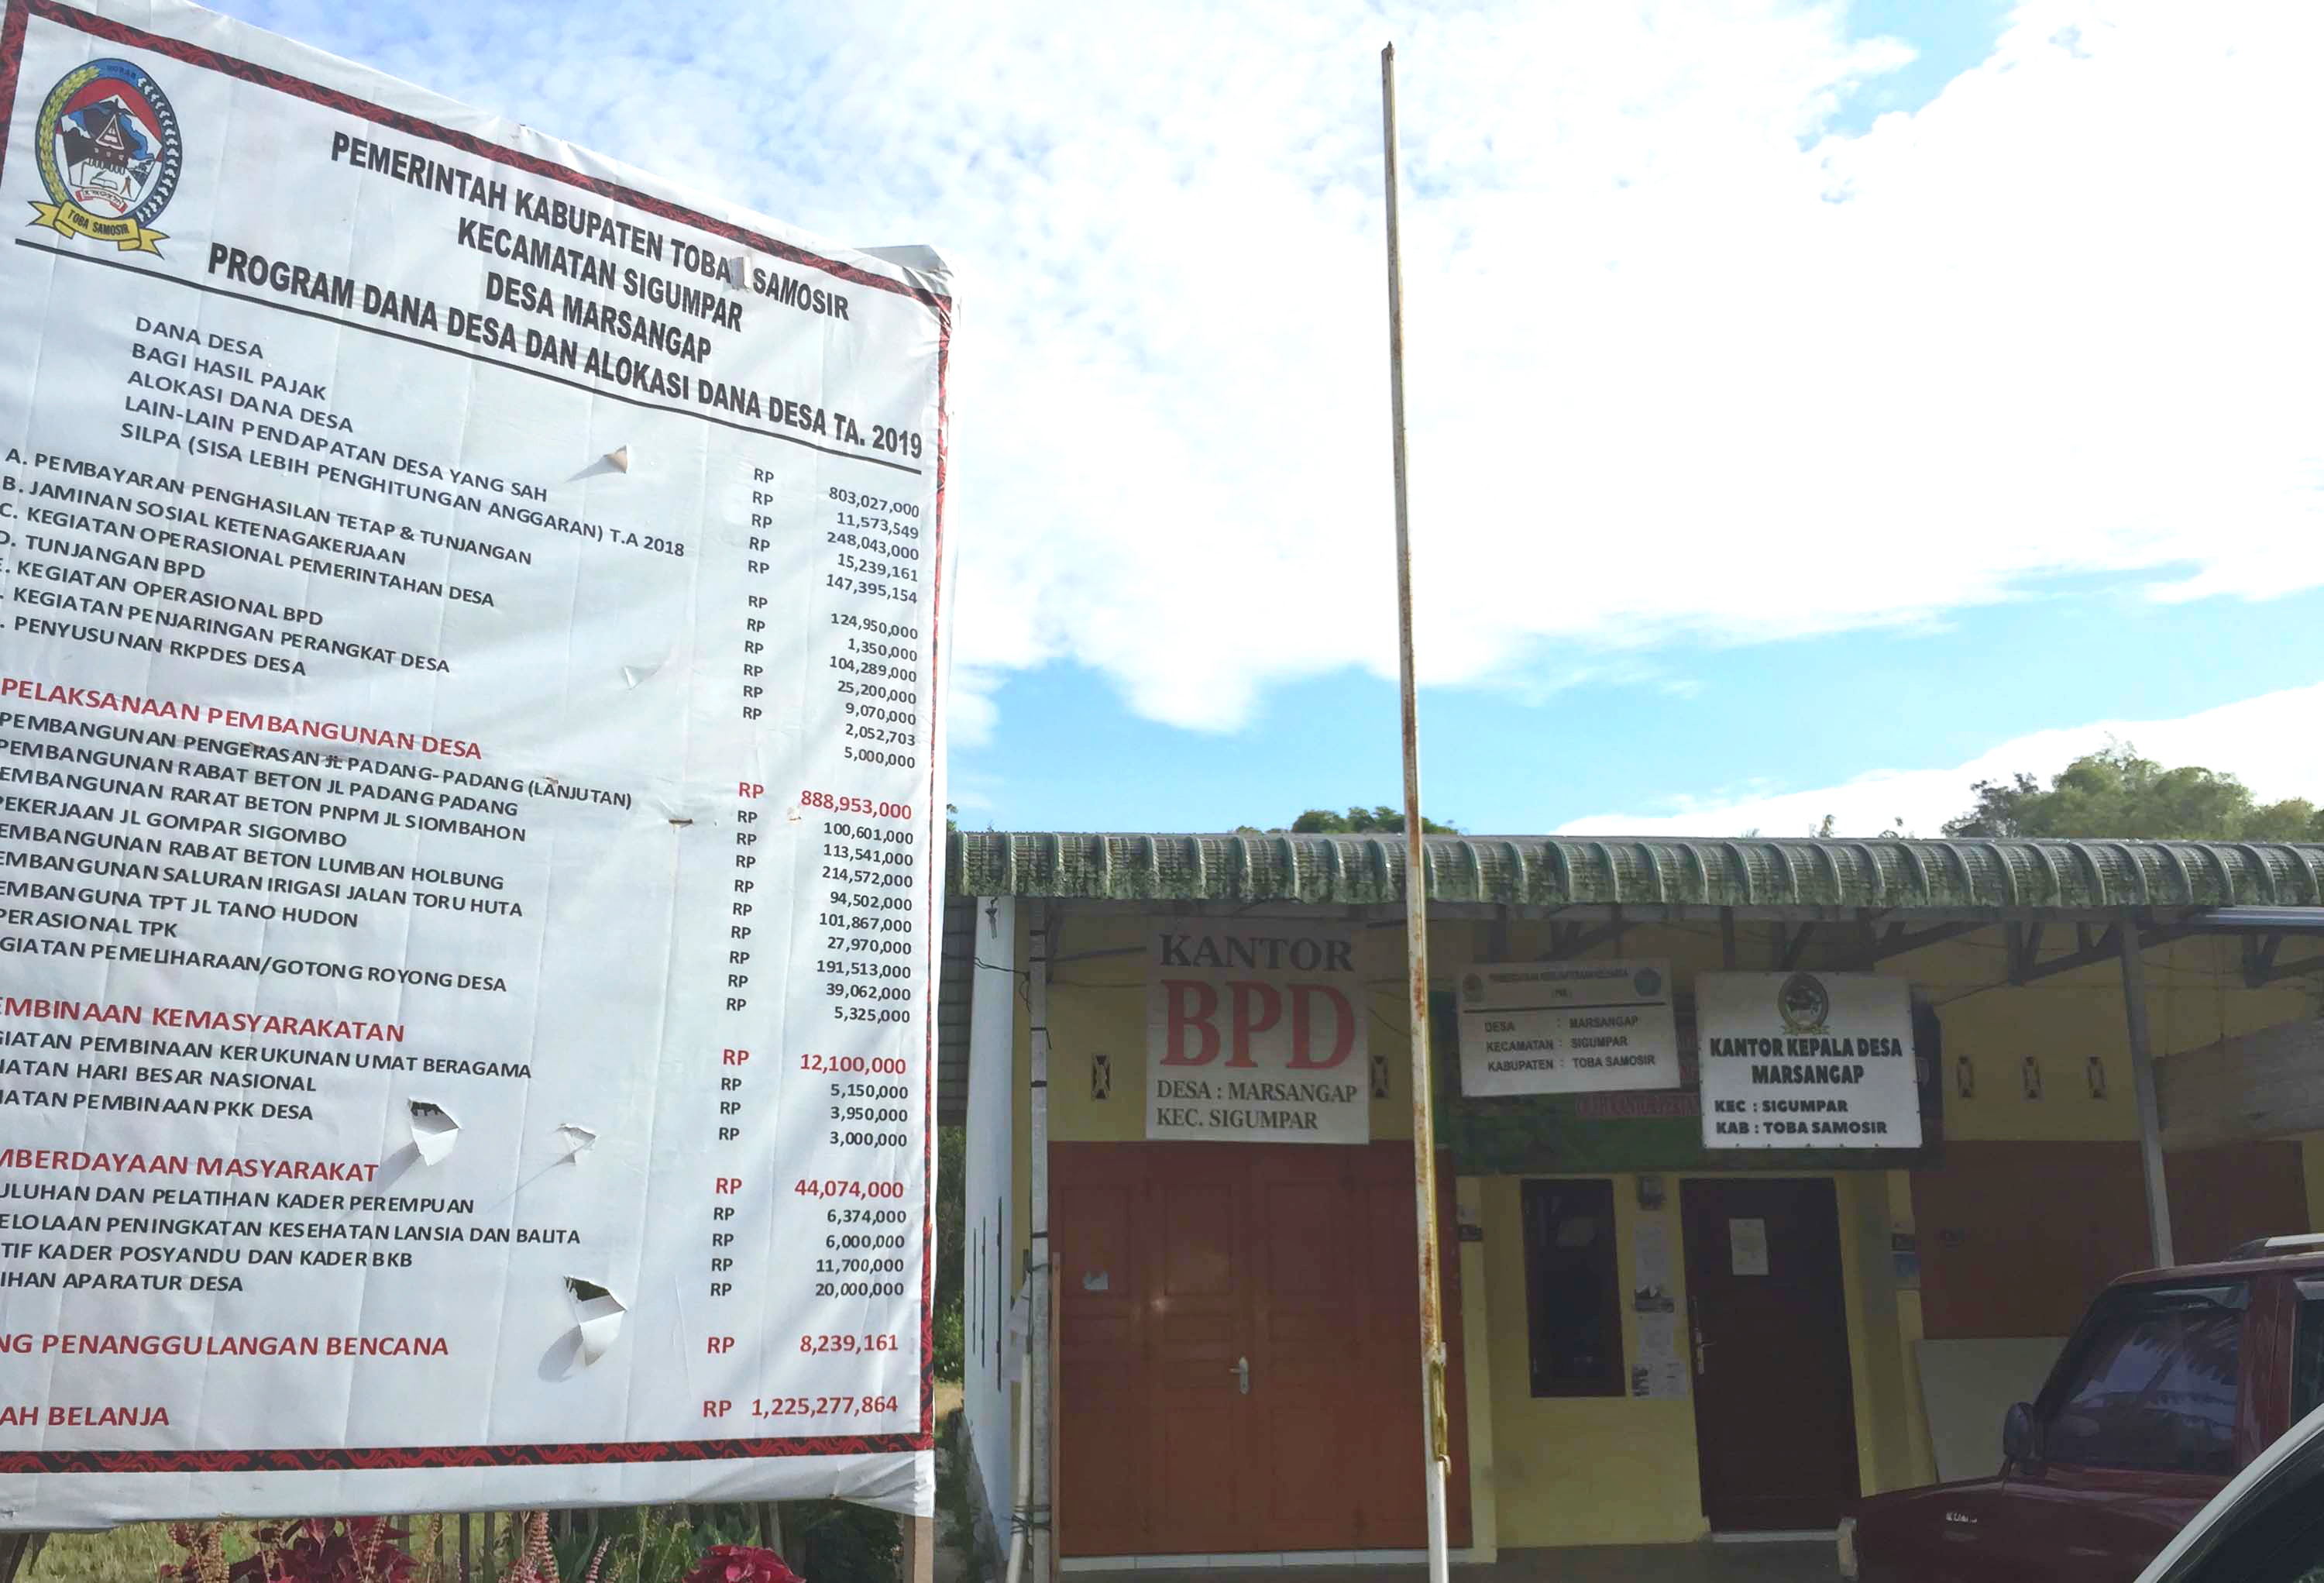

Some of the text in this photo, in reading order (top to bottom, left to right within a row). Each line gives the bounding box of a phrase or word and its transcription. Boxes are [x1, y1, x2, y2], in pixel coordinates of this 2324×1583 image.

[67, 208, 89, 229] TOBA
[332, 131, 849, 321] PEMERINTAH KABUPATEN TOBA SAMOSIR
[458, 217, 743, 332] KECAMATAN SIGUMPAR
[486, 271, 711, 363] DESA MARSANGAP
[136, 317, 263, 359] DANA DESA
[208, 243, 922, 459] PROGRAM DANA DESA DAN ALOKASI DANA DESA TA. 2019
[132, 343, 326, 401] BAGI HASIL PAJAK
[127, 371, 353, 432] ALOKASI DANA DESA
[125, 396, 547, 502] LAIN-LAIN PENDAPATAN DESA YANG SAH
[121, 423, 684, 556] SILPA (SISA LEBIH PENGHITUNGAN ANGGARAN) T.A 2018
[35, 453, 531, 565] PEMBAYARAN PENGHASILAN TETAP TUNJANGAN
[829, 487, 919, 518] 803,027,000
[29, 481, 405, 566] JAMINAN SOSIAL KETENAGAKERJAAN
[837, 512, 918, 539] 11,573,549
[26, 535, 205, 579] TUNJANGAN BPD
[28, 507, 494, 607] KEGIATAN OPERASIONAL PEMERINTAHAN DESA
[827, 532, 919, 560] 248,043,000
[838, 553, 917, 582] 15,239,161
[18, 560, 322, 625] KEGIATAN OPERASIONAL BPD
[827, 574, 917, 604] 147,395,154
[14, 587, 449, 673] KEGIATAN PENJARINGAN PERANGKAT DESA
[831, 613, 918, 639] 124,950,000
[15, 616, 306, 676] PENYUSUNAN RKPDES DESA
[848, 638, 917, 662] 1,350,000
[830, 656, 916, 682] 104,289,000
[837, 680, 916, 704] 25,200,000
[2, 678, 481, 759] PELAKSANAAN PEMBANGUNAN DESA
[845, 703, 916, 725] 9,070,000
[846, 724, 915, 746] 2,052,703
[844, 746, 915, 769] 5,000,000
[739, 782, 911, 820] RP 888,953,000
[147, 813, 346, 847] GOMPAR SIGOMBO
[824, 822, 913, 845] 100,601,000
[824, 844, 913, 866] 113,541,000
[163, 867, 340, 898] SALURAN IRIGASI
[318, 857, 504, 890] LUMBAN HOLBUNG
[823, 866, 913, 888] 214,572,000
[830, 892, 912, 911] 94,502,000
[820, 913, 911, 933] 101,867,000
[827, 937, 911, 955] 27,970,000
[1160, 934, 1354, 972] KANTOR
[91, 944, 363, 979] PEMELIHARAAN/GOTONG
[817, 960, 910, 979] 191,513,000
[826, 982, 910, 1001] 39,062,000
[153, 1008, 404, 1042] KEMASYARAKATAN
[834, 1006, 909, 1024] 5,325,000
[1160, 979, 1356, 1069] BPD
[1485, 1016, 1638, 1033] DESA MARSANGAP
[1486, 1036, 1628, 1052] KECAMATAN SIGUMPAR
[1710, 1038, 1903, 1058] KANTOR KEPALA DESA
[80, 1036, 531, 1079] PEMBINAAN BERAGAMA
[724, 1049, 906, 1075] RP 12,100,000
[1487, 1055, 1655, 1072] KABUPATEN TOBA SAMOSIR
[77, 1064, 316, 1091] HARI BESAR NASIONAL
[1752, 1065, 1865, 1085] MARSANGAP
[830, 1083, 908, 1100] 5,150,000
[1157, 1080, 1358, 1103] DESA MARSANGAP
[830, 1106, 907, 1123] 3,950,000
[1714, 1099, 1849, 1113] KEC SIGUMPAR
[1157, 1107, 1318, 1130] KEC. SIGUMPAR
[1716, 1122, 1888, 1134] KAB TOBA SAMOSIR
[830, 1131, 906, 1148] 3,000,000
[197, 1157, 378, 1182] MASYARAKAT
[153, 1189, 473, 1213] PELATIHAN KADER PEREMPUAN
[716, 1178, 903, 1200] RP 44,074,000
[827, 1209, 906, 1226] 6,374,000
[107, 1217, 580, 1244] PENINGKATAN KESEHATAN LANSIA BALITA
[826, 1235, 904, 1251] 6,000,000
[120, 1247, 240, 1264] POSYANDU
[816, 1258, 903, 1275] 11,700,000
[816, 1282, 903, 1299] 20,000,000
[42, 1335, 449, 1355] PENANGGULANGAN BENCANA
[707, 1334, 898, 1355] RP 8,239,161
[49, 1407, 169, 1426] BELANJA
[703, 1396, 898, 1419] RP 1,225,277,864
